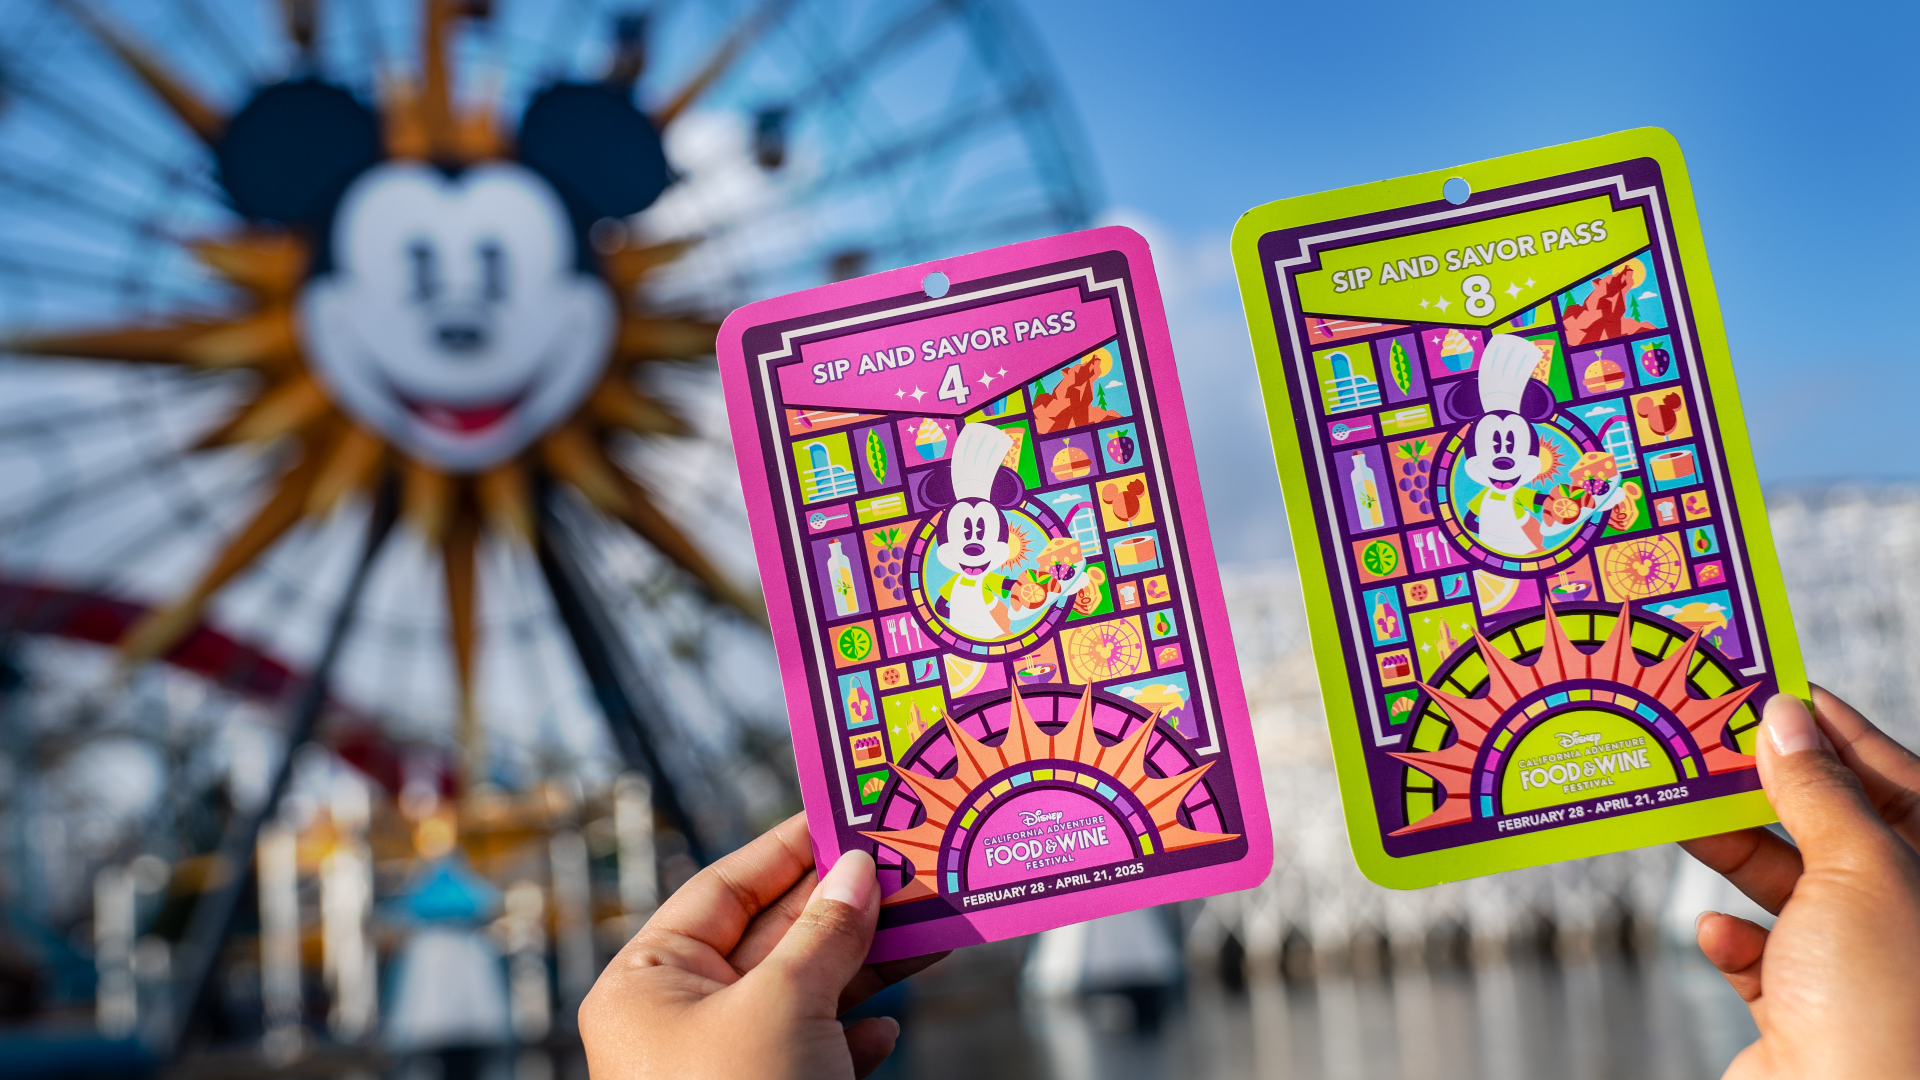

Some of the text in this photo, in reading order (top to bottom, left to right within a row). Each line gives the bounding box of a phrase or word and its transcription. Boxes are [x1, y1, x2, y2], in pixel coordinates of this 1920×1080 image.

[1332, 220, 1607, 292] SIP AND SAVOR PASS
[1461, 274, 1496, 317] 8
[812, 311, 1077, 385] SIP AND SAVOR PASS
[937, 364, 970, 405] 4
[1518, 737, 1645, 768] CALIFORNIA ADVENTURE
[1520, 762, 1581, 790] FOOD
[1593, 748, 1651, 775] WINE
[1562, 777, 1615, 794] FESTIVAL
[1497, 809, 1565, 832] FEBRUARY
[1568, 806, 1584, 819] 28
[1595, 798, 1632, 814] APRIL
[1635, 793, 1655, 805] 21,
[1657, 786, 1689, 802] 2025
[983, 815, 1105, 846] CALIFORNIA ADVENTURE
[985, 839, 1043, 867] FOOD
[1055, 826, 1109, 852] WINE
[1025, 854, 1075, 871] FESTIVAL
[962, 885, 1027, 907] FEBRUARY
[1030, 882, 1045, 894] 28
[1055, 873, 1091, 890] APRIL
[1093, 869, 1112, 881] 21,
[1115, 863, 1144, 877] 2025
